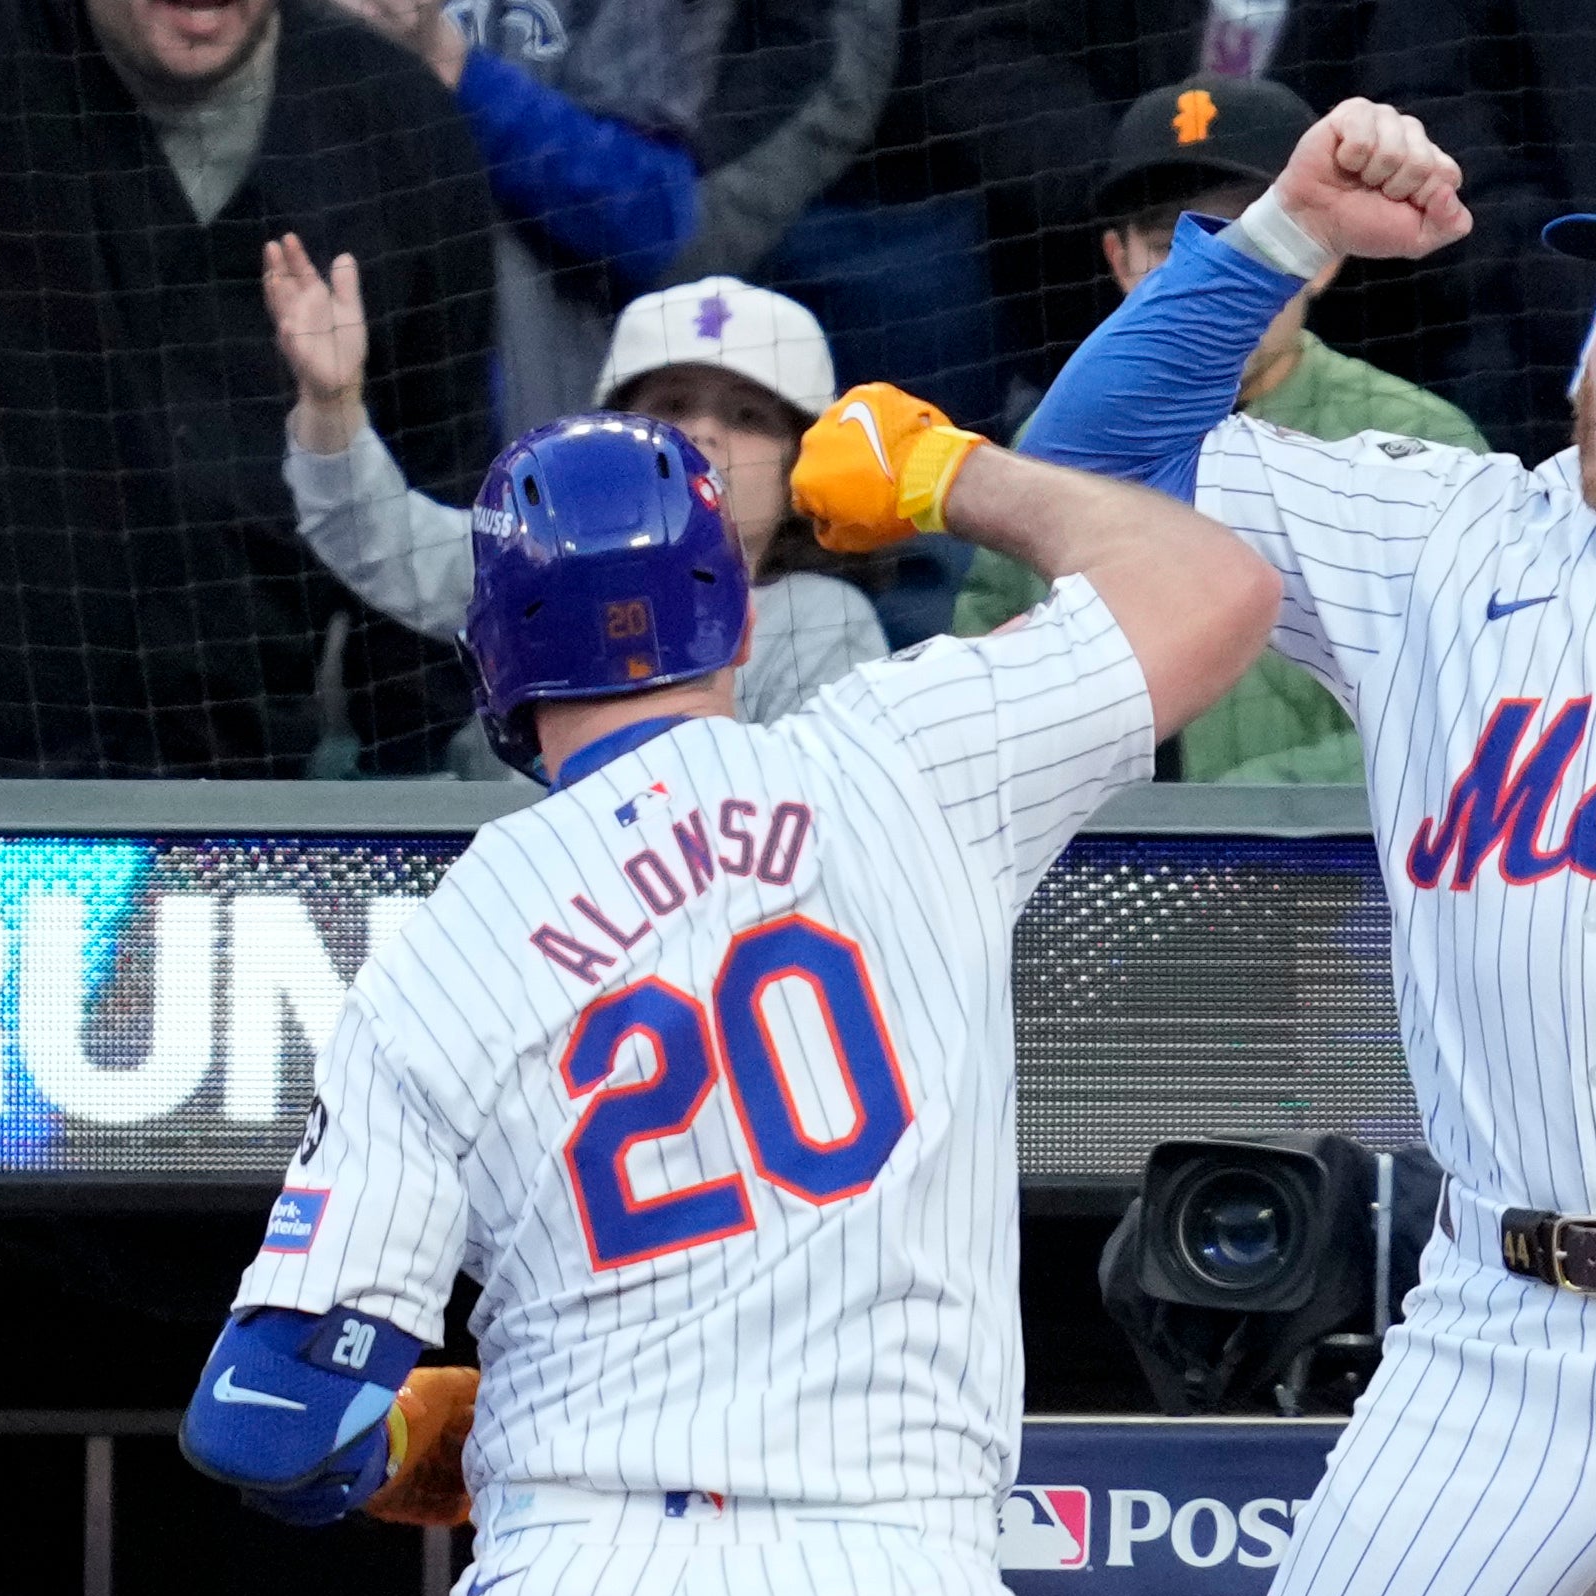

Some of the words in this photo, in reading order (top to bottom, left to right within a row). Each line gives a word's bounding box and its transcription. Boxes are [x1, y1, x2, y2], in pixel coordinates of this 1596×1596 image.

[529, 798, 812, 986] ALONSO
[558, 911, 915, 1273] 20
[1504, 1230, 1531, 1269] 44
[331, 1318, 377, 1370] 20
